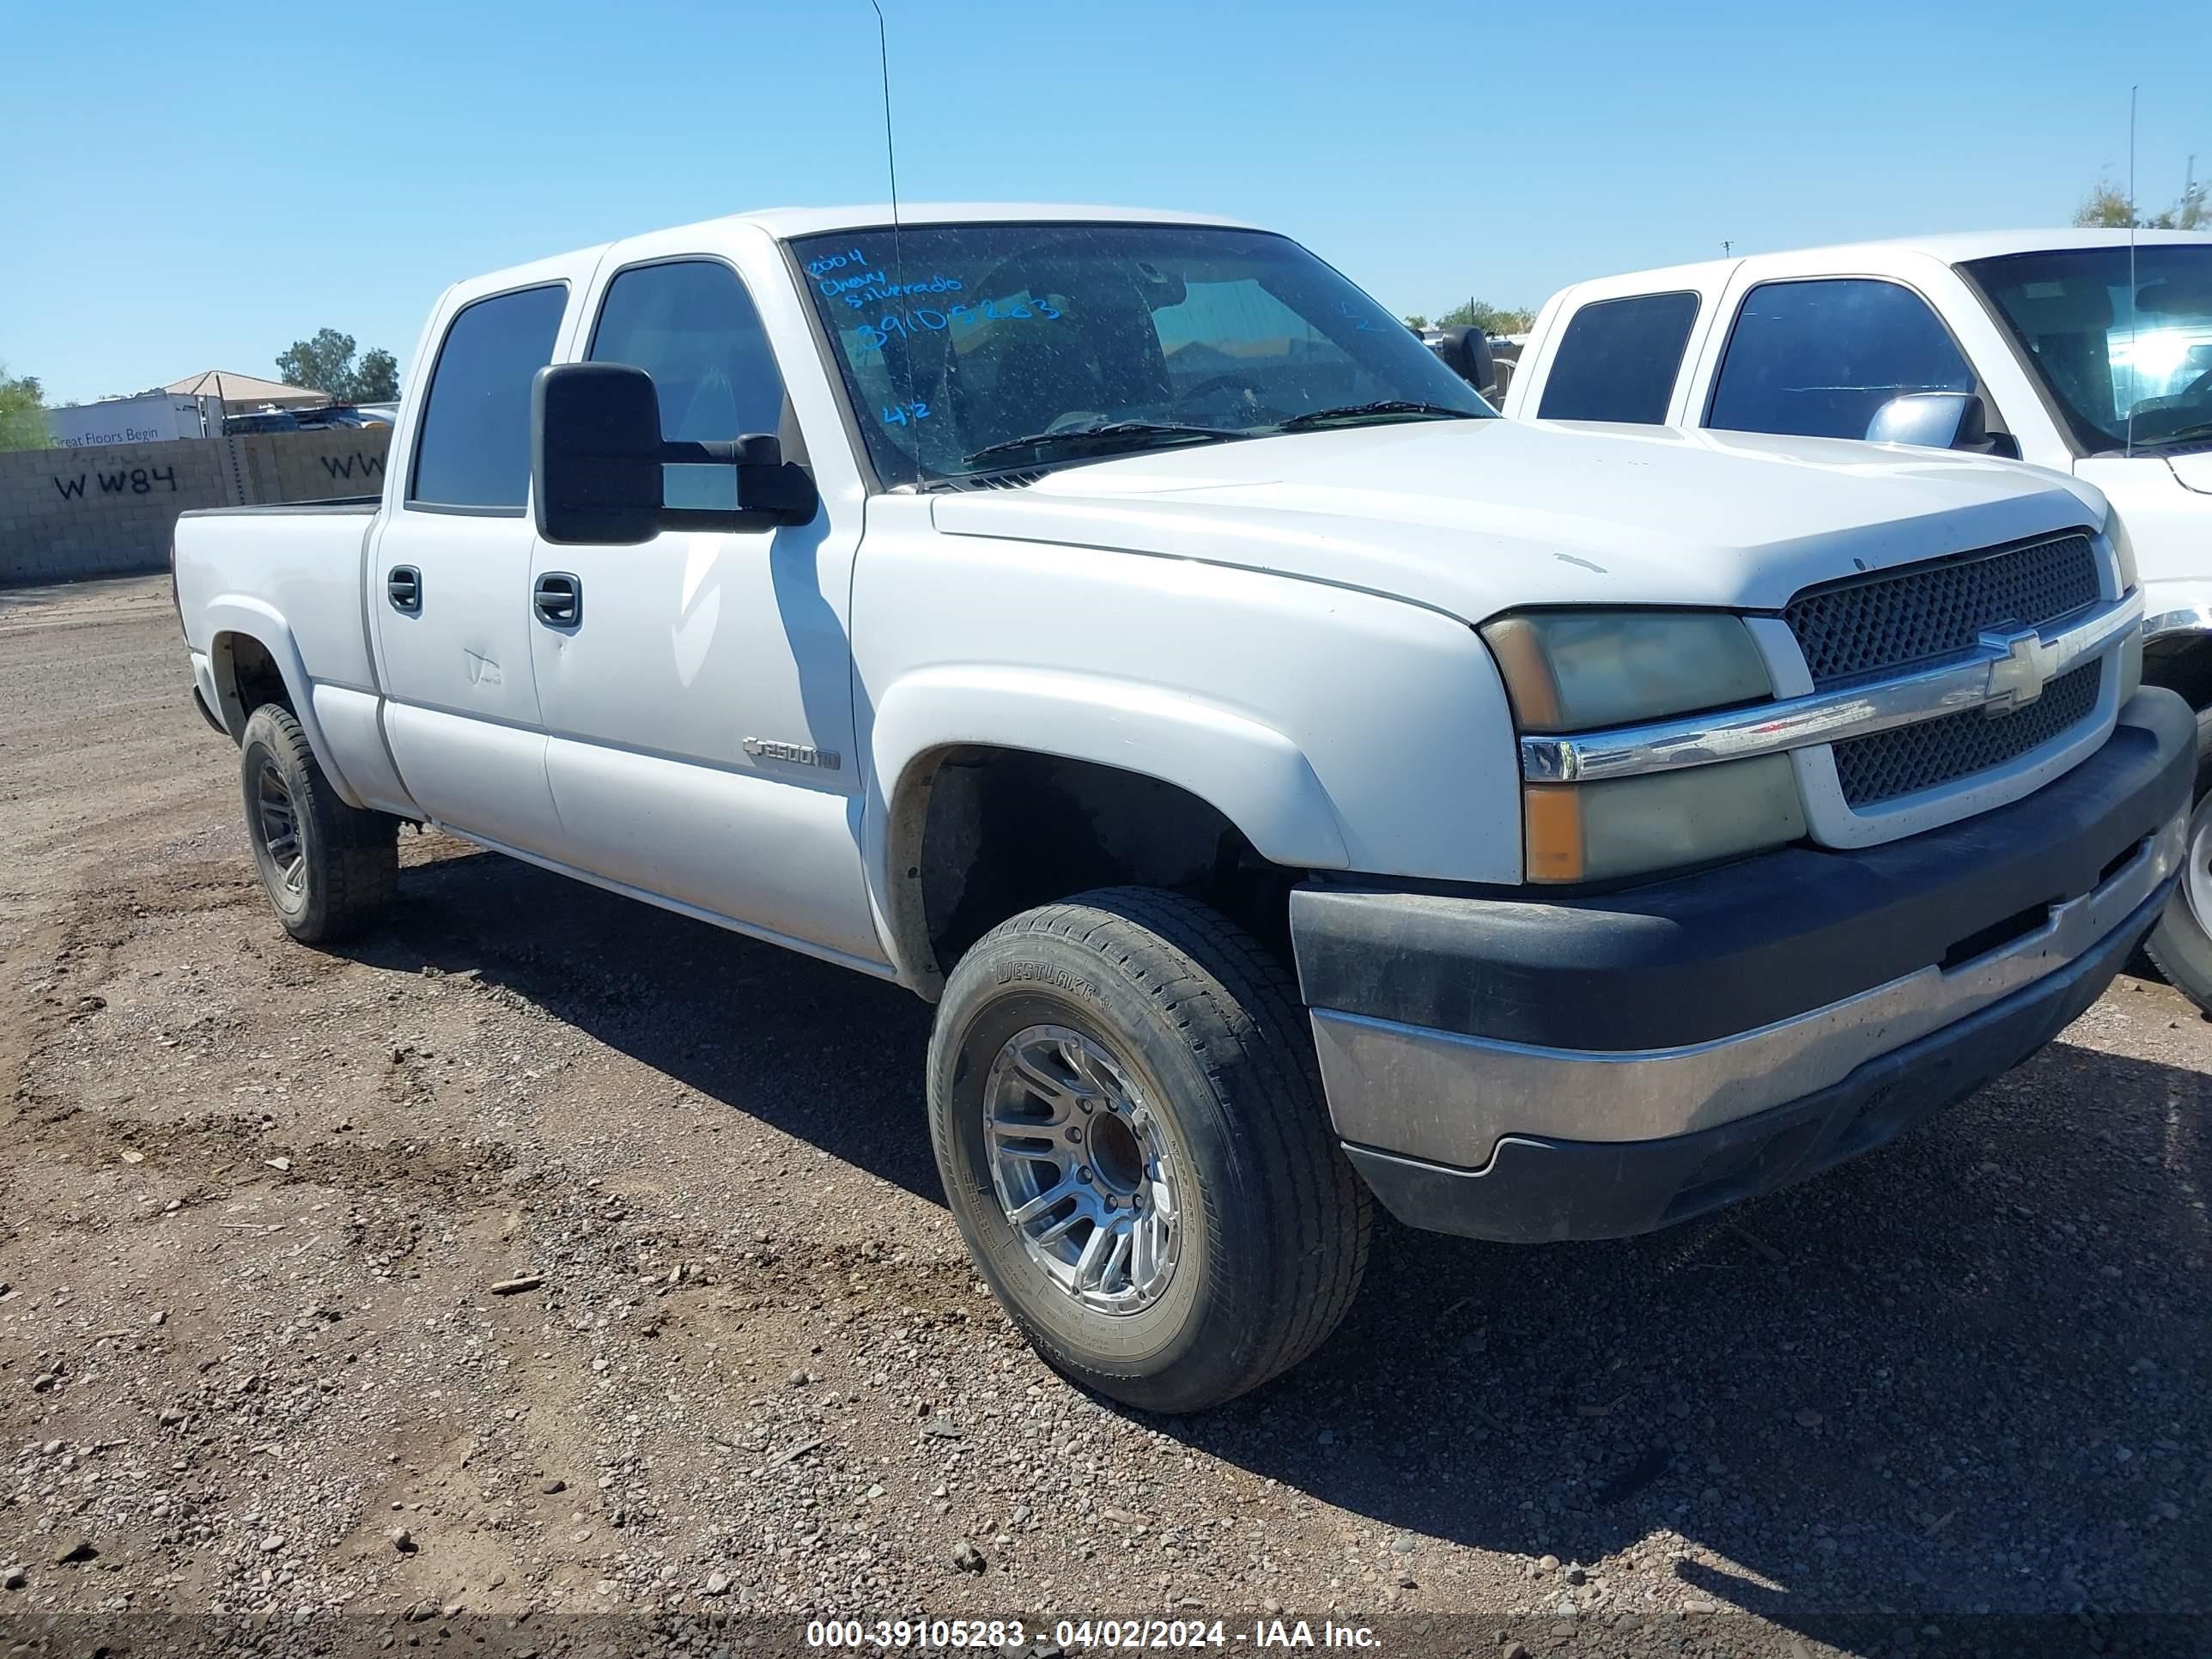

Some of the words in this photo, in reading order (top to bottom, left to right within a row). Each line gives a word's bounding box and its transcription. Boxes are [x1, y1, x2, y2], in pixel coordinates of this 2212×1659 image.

[809, 248, 868, 276] 2004
[86, 433, 123, 445] Floors
[125, 428, 158, 442] Begin
[996, 960, 1097, 1003] WESTLAKE
